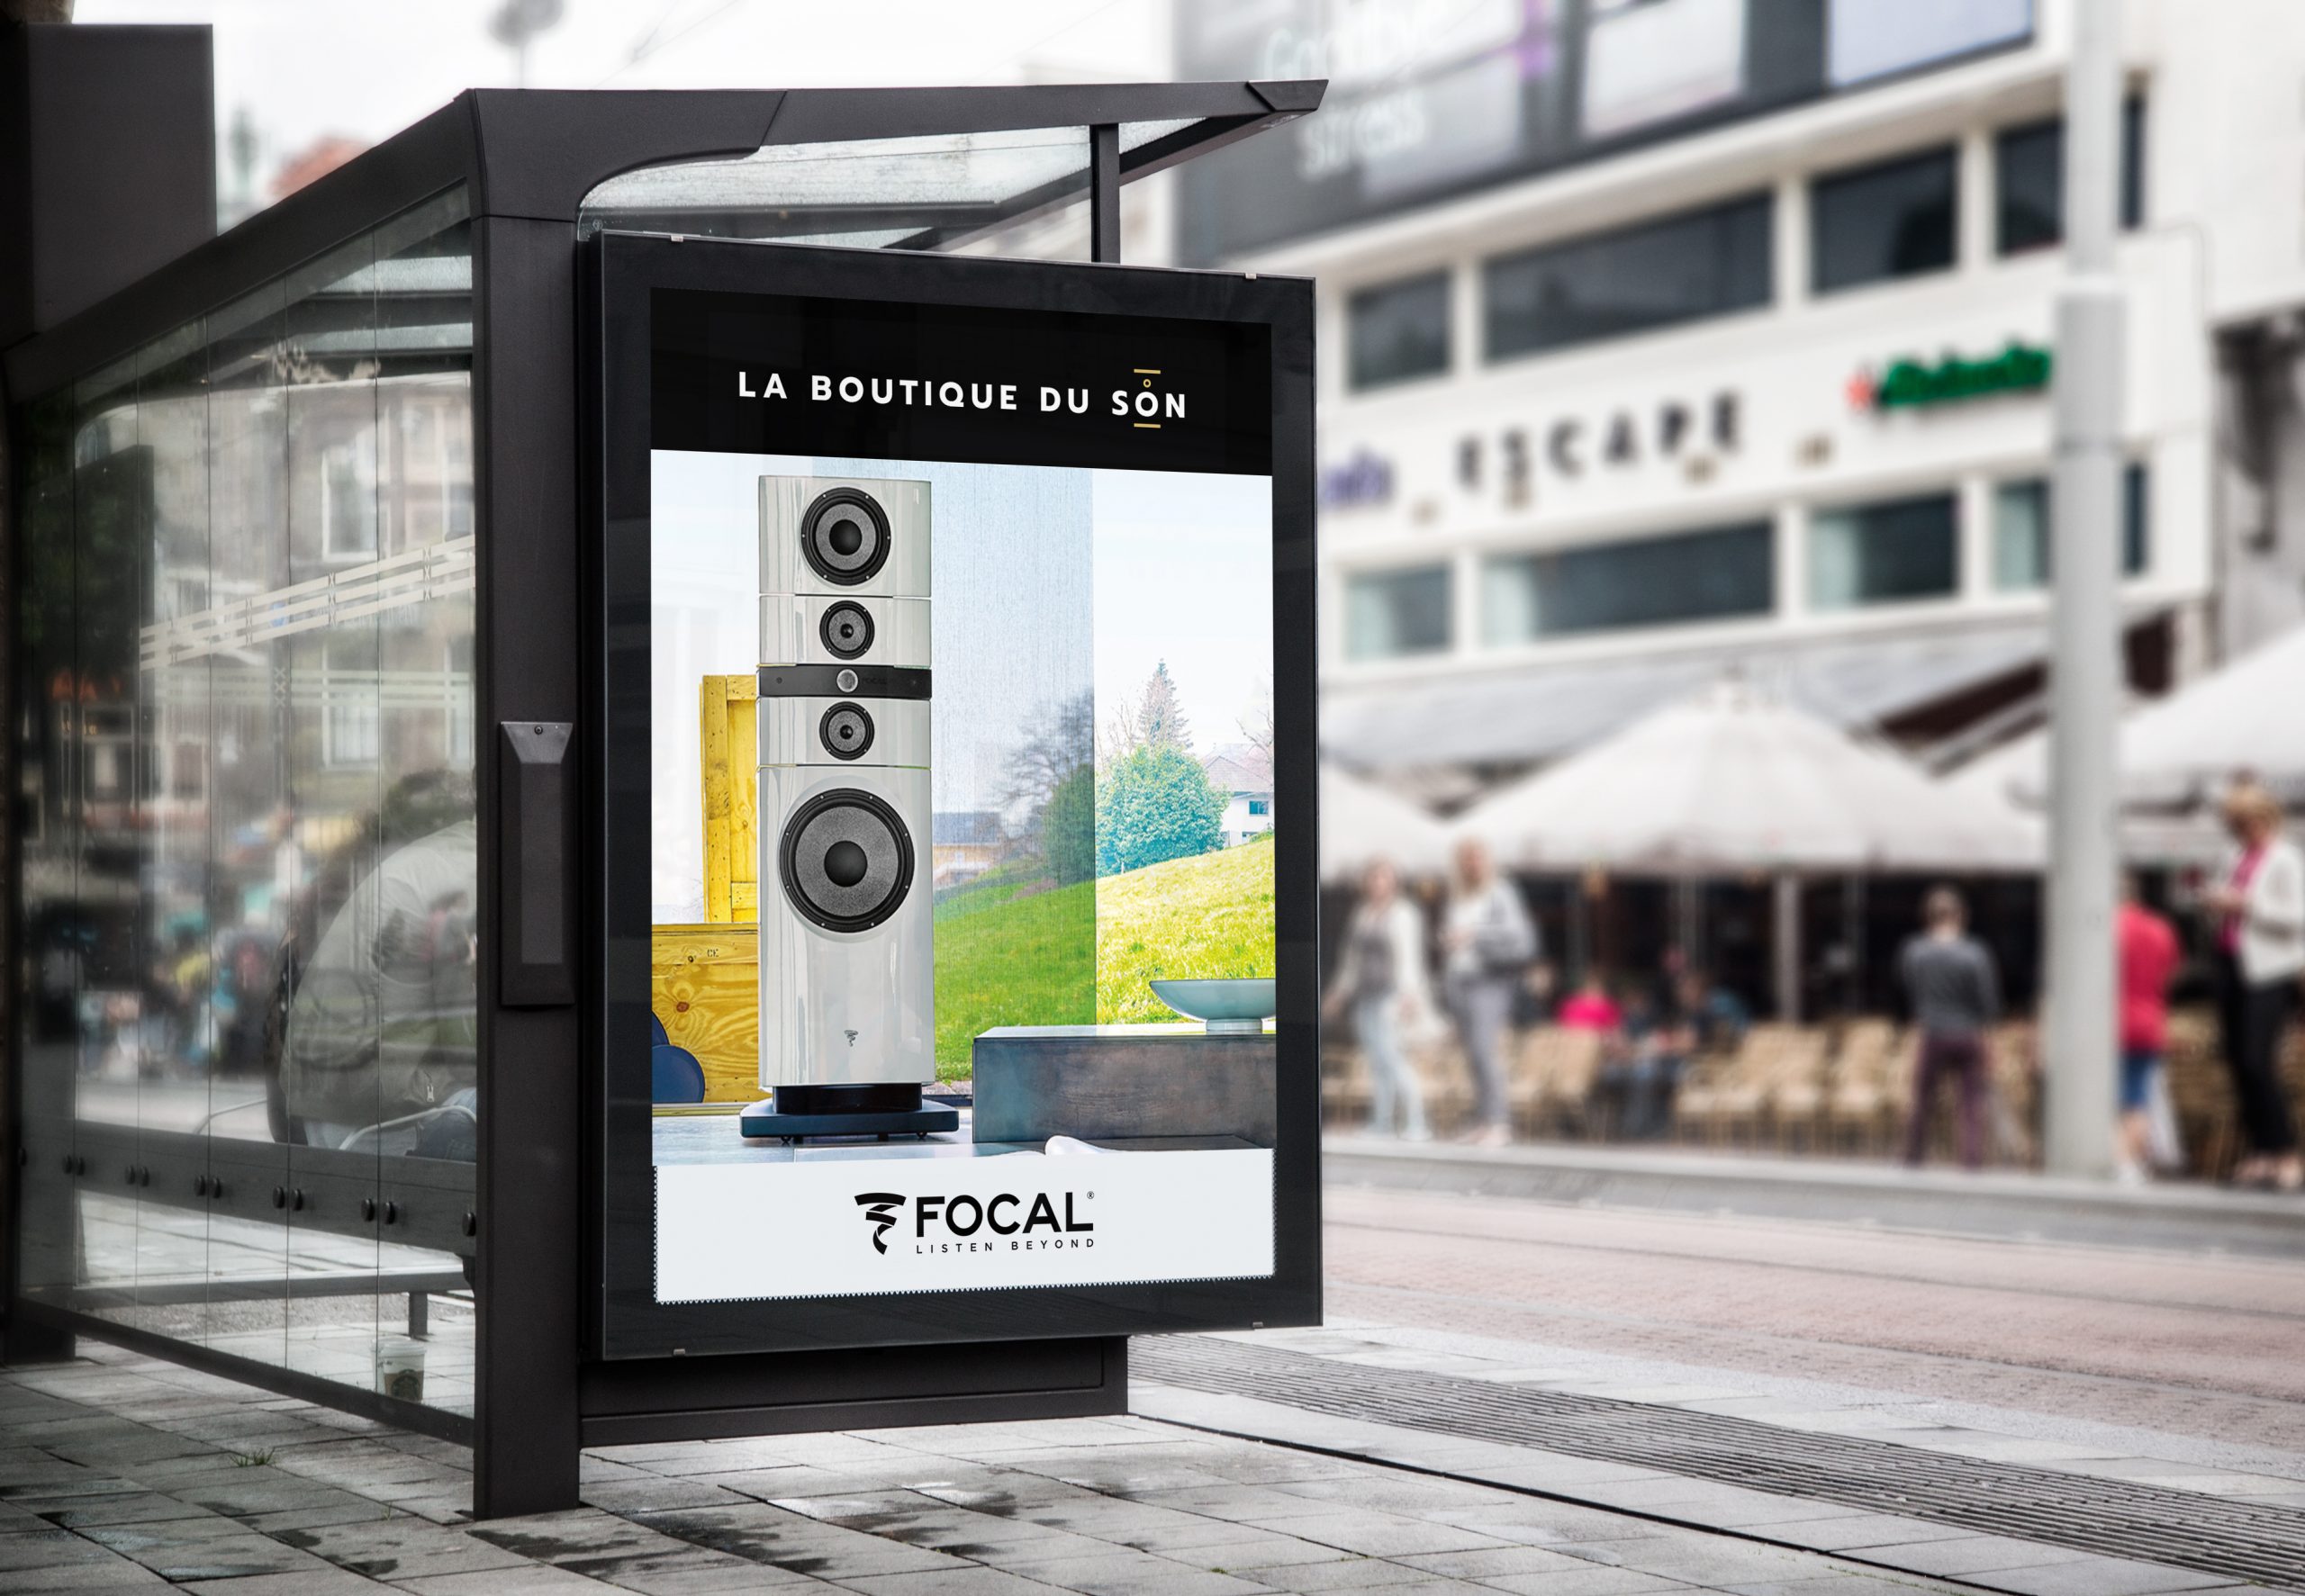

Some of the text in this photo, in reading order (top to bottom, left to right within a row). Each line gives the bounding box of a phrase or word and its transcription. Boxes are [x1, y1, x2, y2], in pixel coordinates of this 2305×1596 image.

[738, 371, 1186, 419] LA BOUTIQUE DU SON
[1457, 391, 1740, 492] ESCAPE
[916, 1238, 1094, 1254] LISTEN BEYOND
